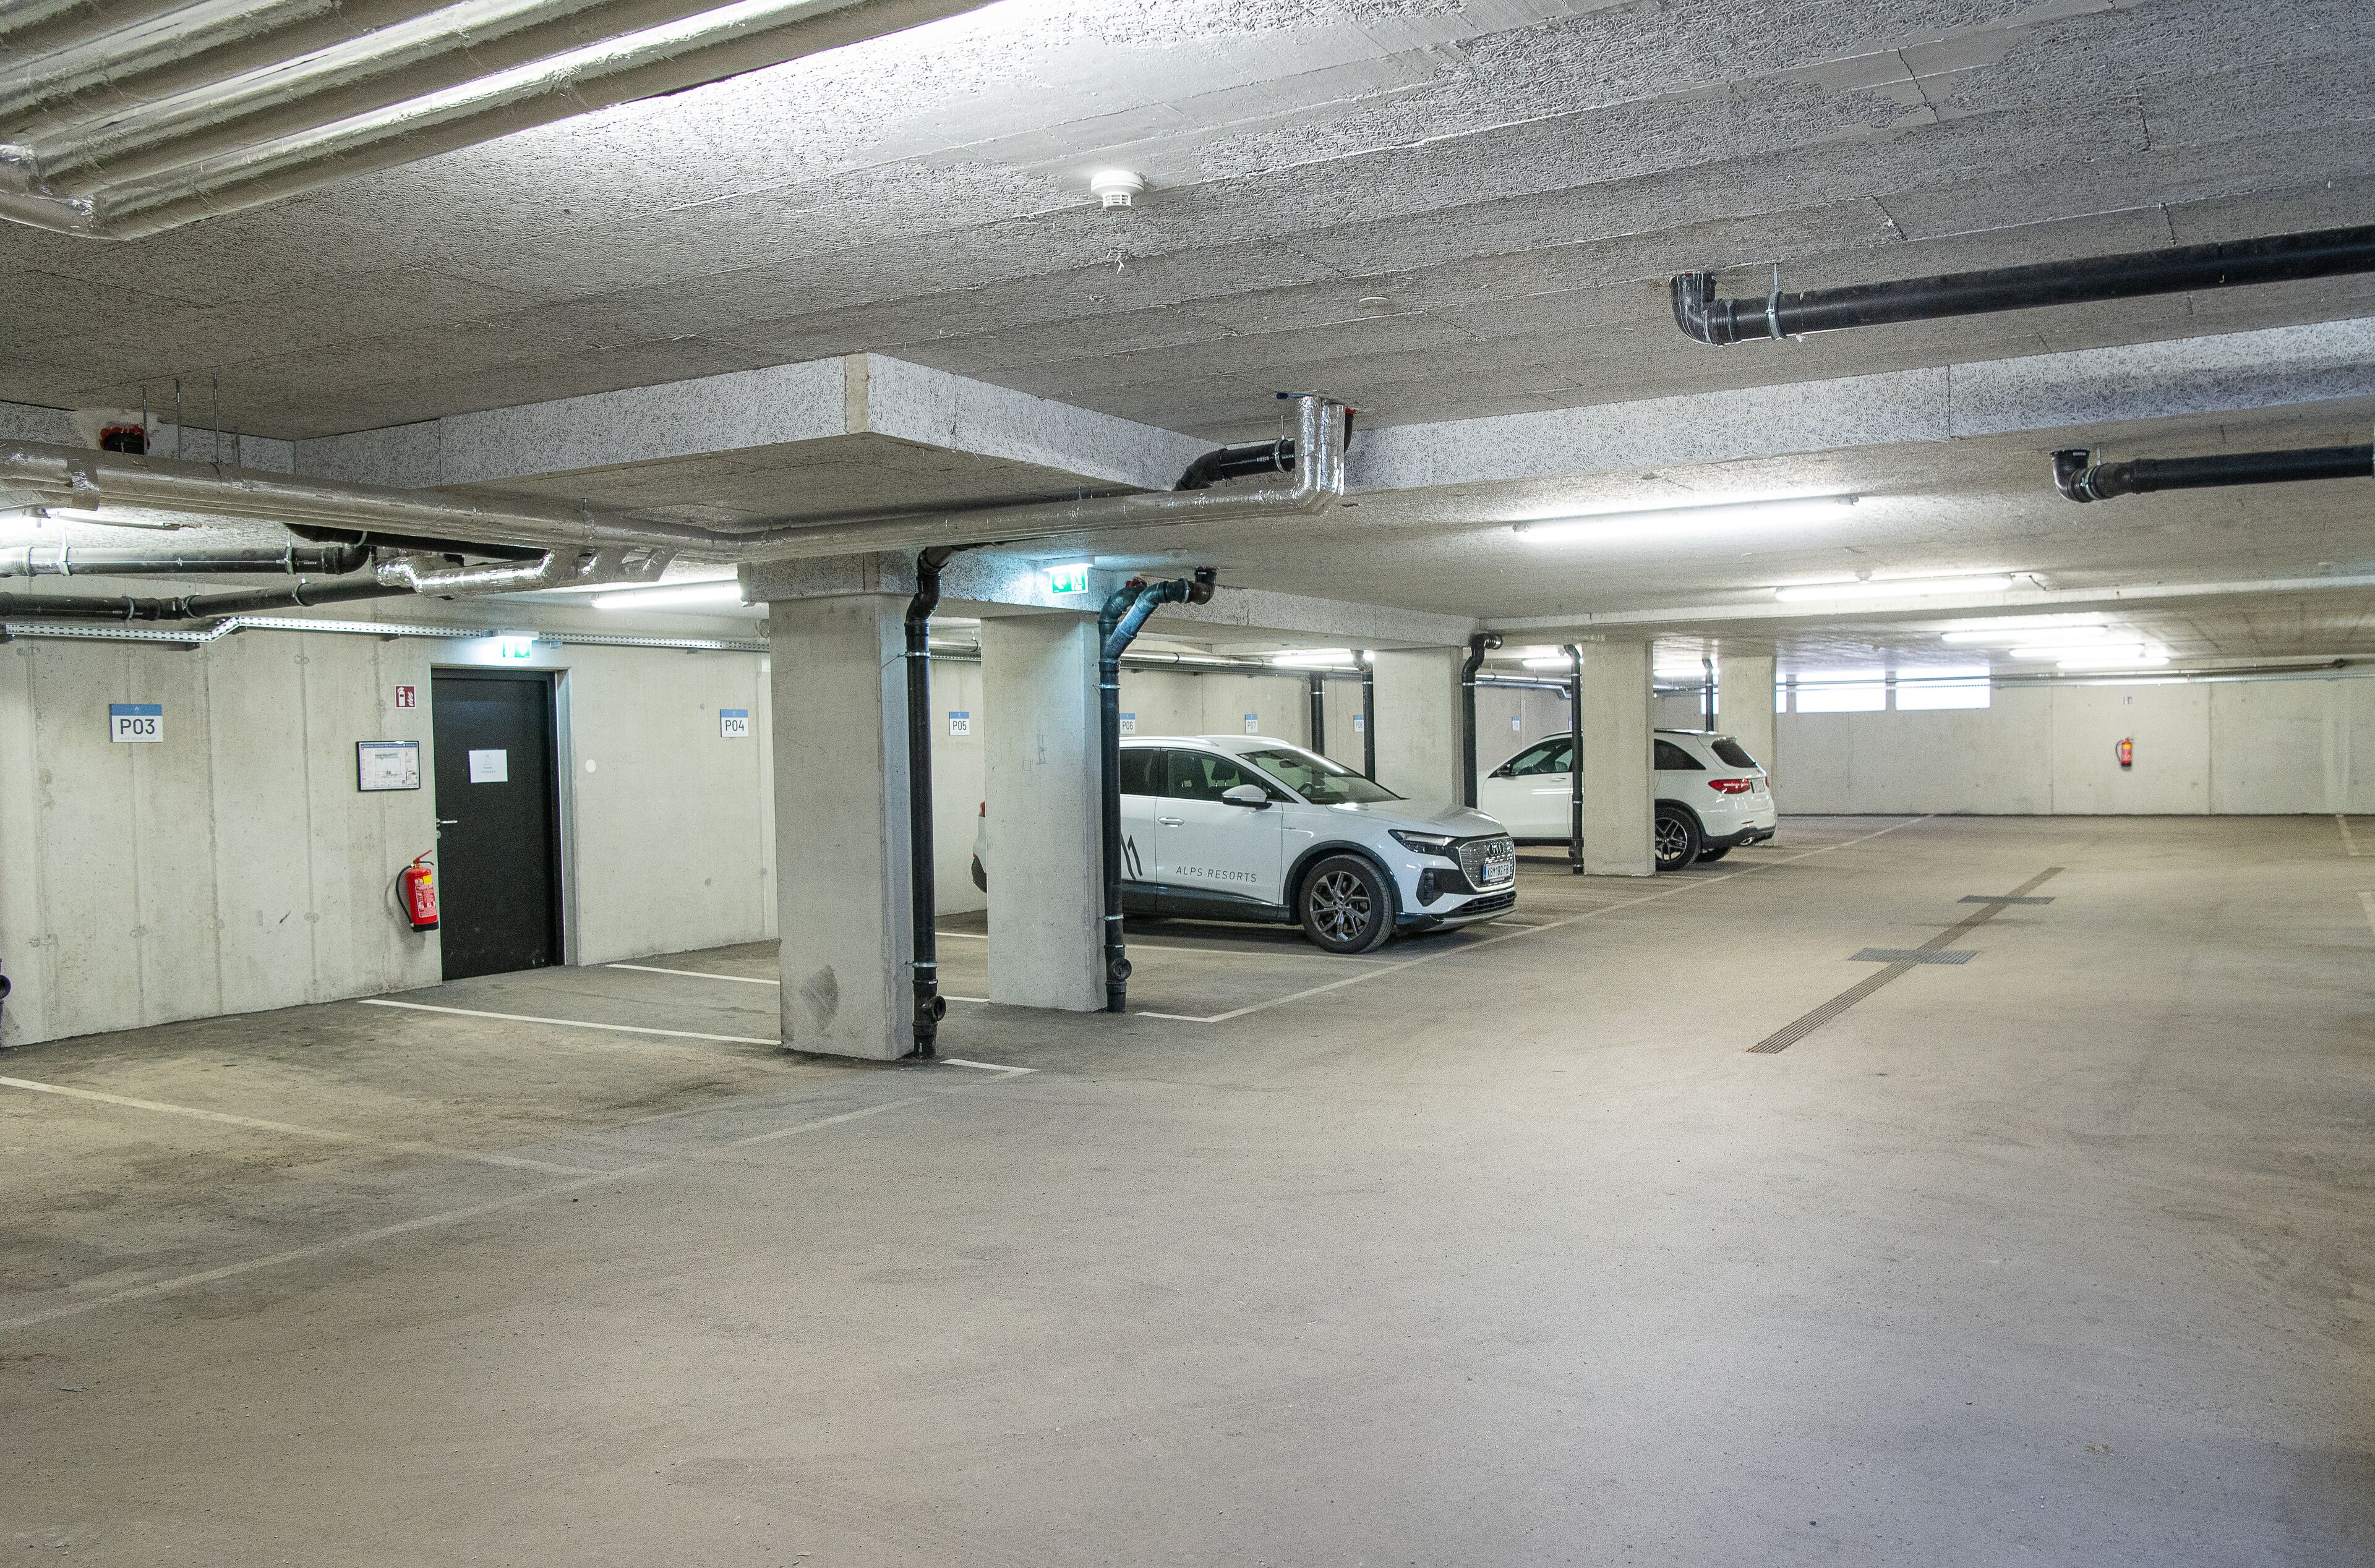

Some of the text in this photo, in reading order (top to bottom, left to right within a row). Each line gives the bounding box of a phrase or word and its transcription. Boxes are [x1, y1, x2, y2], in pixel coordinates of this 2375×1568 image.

[120, 718, 155, 735] P03
[725, 720, 745, 731] P04
[952, 720, 967, 730] P05
[1122, 721, 1133, 730] P06
[1247, 721, 1256, 729] P07
[1176, 866, 1257, 882] ALPS RESORTS
